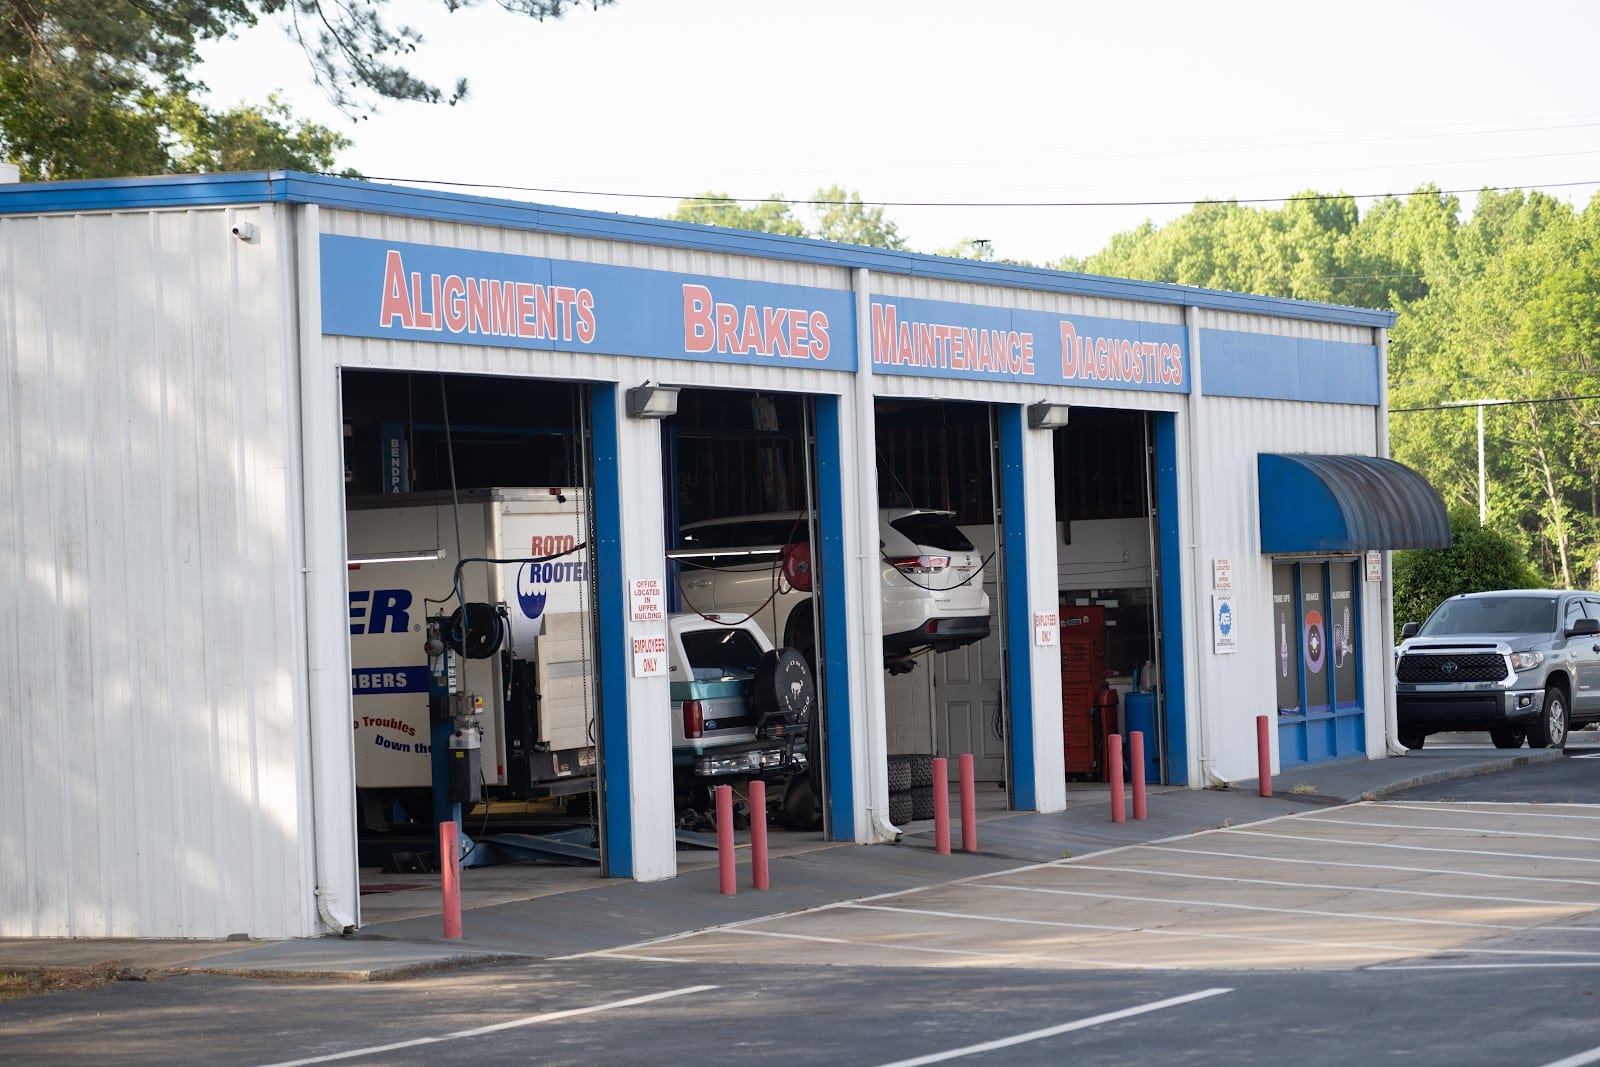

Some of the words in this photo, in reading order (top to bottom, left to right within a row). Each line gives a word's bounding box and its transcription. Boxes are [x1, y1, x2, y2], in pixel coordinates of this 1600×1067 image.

[380, 250, 596, 343] ALIGNMENTS
[682, 284, 830, 361] BRAKES
[871, 303, 1034, 375] MAINTENANCE
[1060, 320, 1182, 385] DIAGNOSTICS
[531, 535, 575, 556] ROTO
[634, 589, 660, 597] LOCATED
[636, 580, 657, 588] OFFICE
[634, 612, 662, 620] BUILDING
[638, 604, 657, 612] UPPER
[634, 638, 665, 653] EMPLOYEES
[643, 658, 658, 673] ONLY
[352, 672, 408, 689] BERS
[362, 716, 416, 737] Troubles
[375, 734, 411, 753] Down
